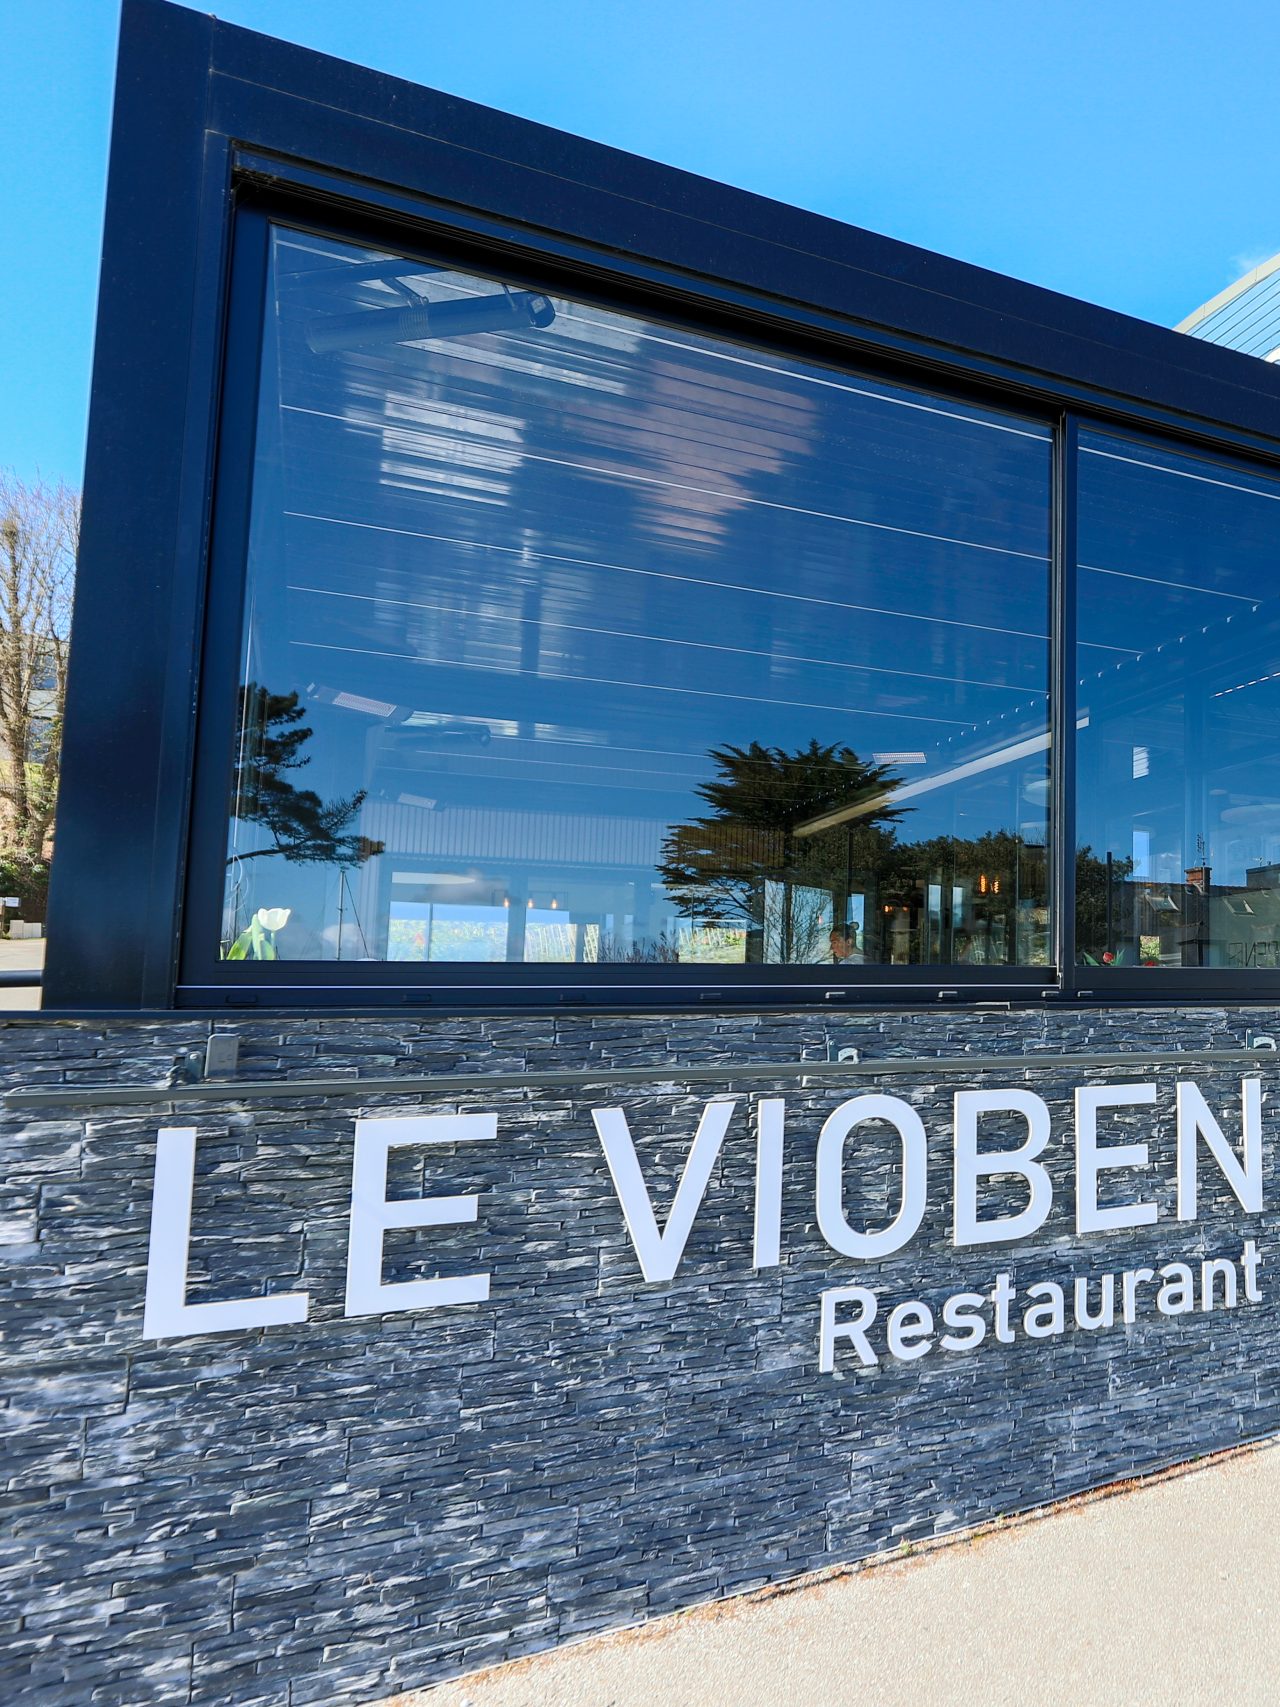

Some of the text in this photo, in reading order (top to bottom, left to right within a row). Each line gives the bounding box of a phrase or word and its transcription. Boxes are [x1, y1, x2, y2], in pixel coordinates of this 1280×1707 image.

[142, 1078, 1264, 1340] LE VIOBEN
[819, 1240, 1264, 1374] Restaurant
